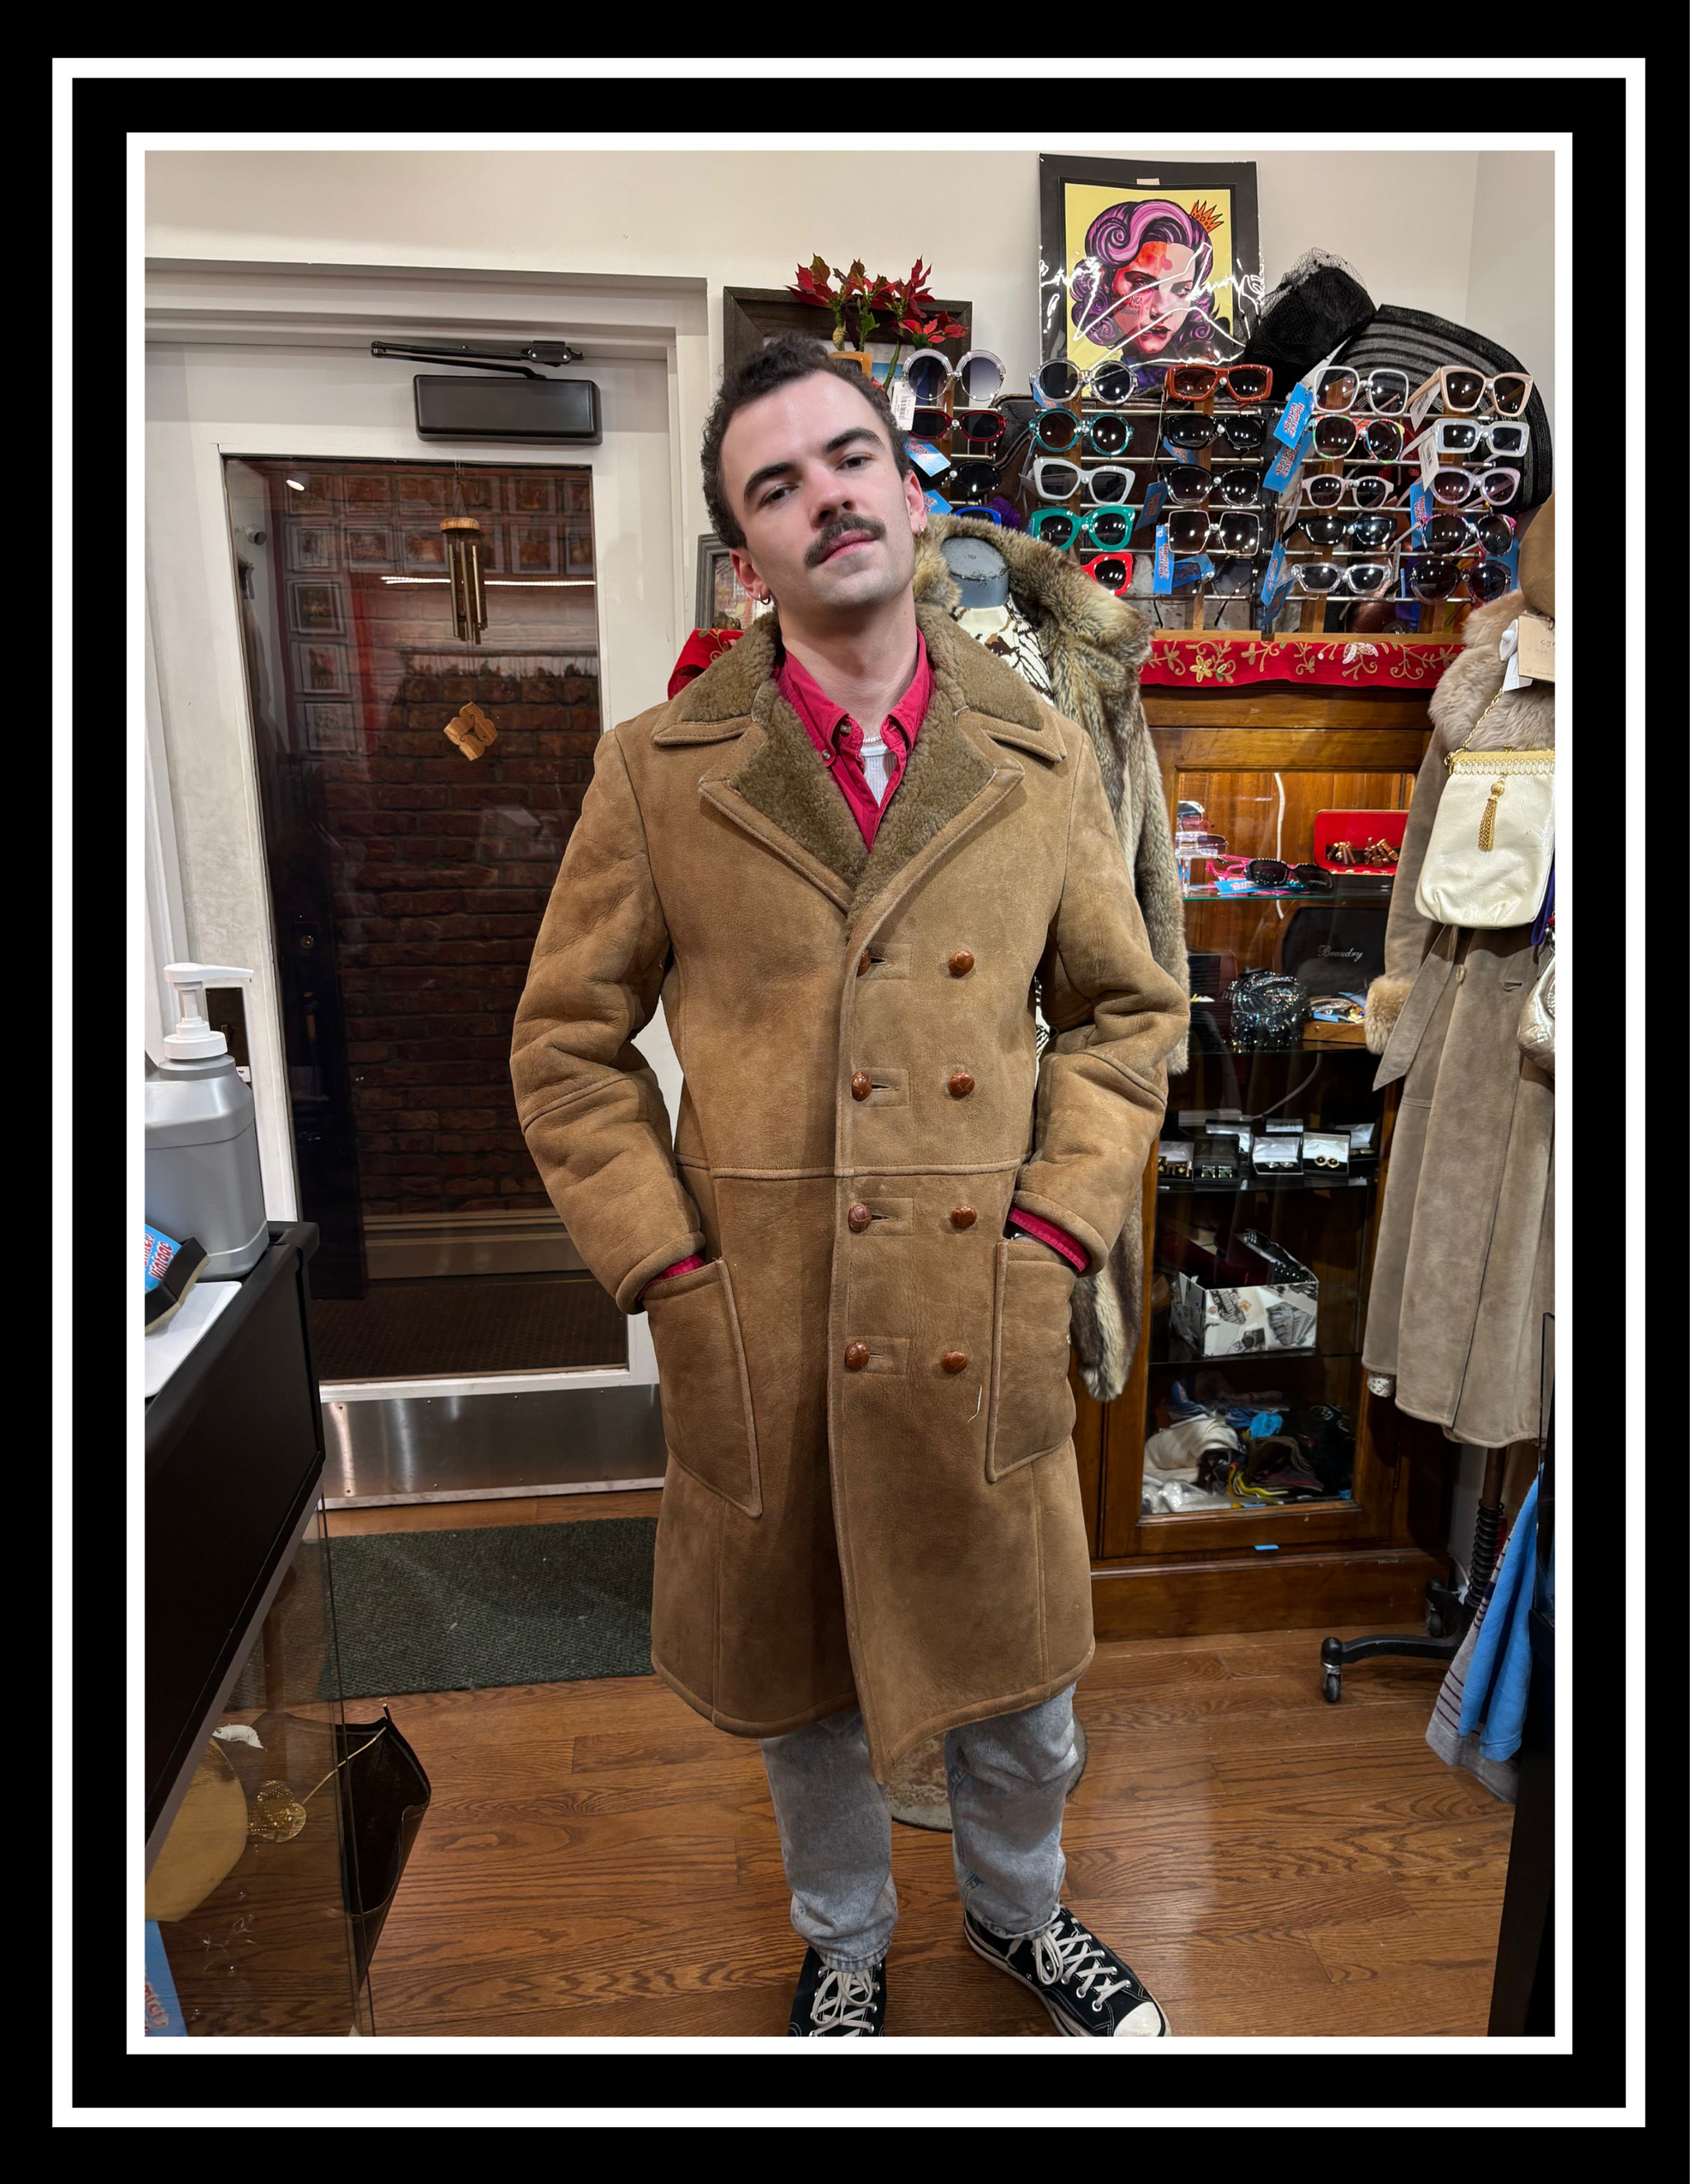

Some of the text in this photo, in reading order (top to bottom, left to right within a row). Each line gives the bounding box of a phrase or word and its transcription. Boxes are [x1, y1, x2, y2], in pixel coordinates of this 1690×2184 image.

[1284, 403, 1296, 433] Vintage
[1317, 945, 1363, 962] Beaudry
[149, 1241, 174, 1280] Vintage
